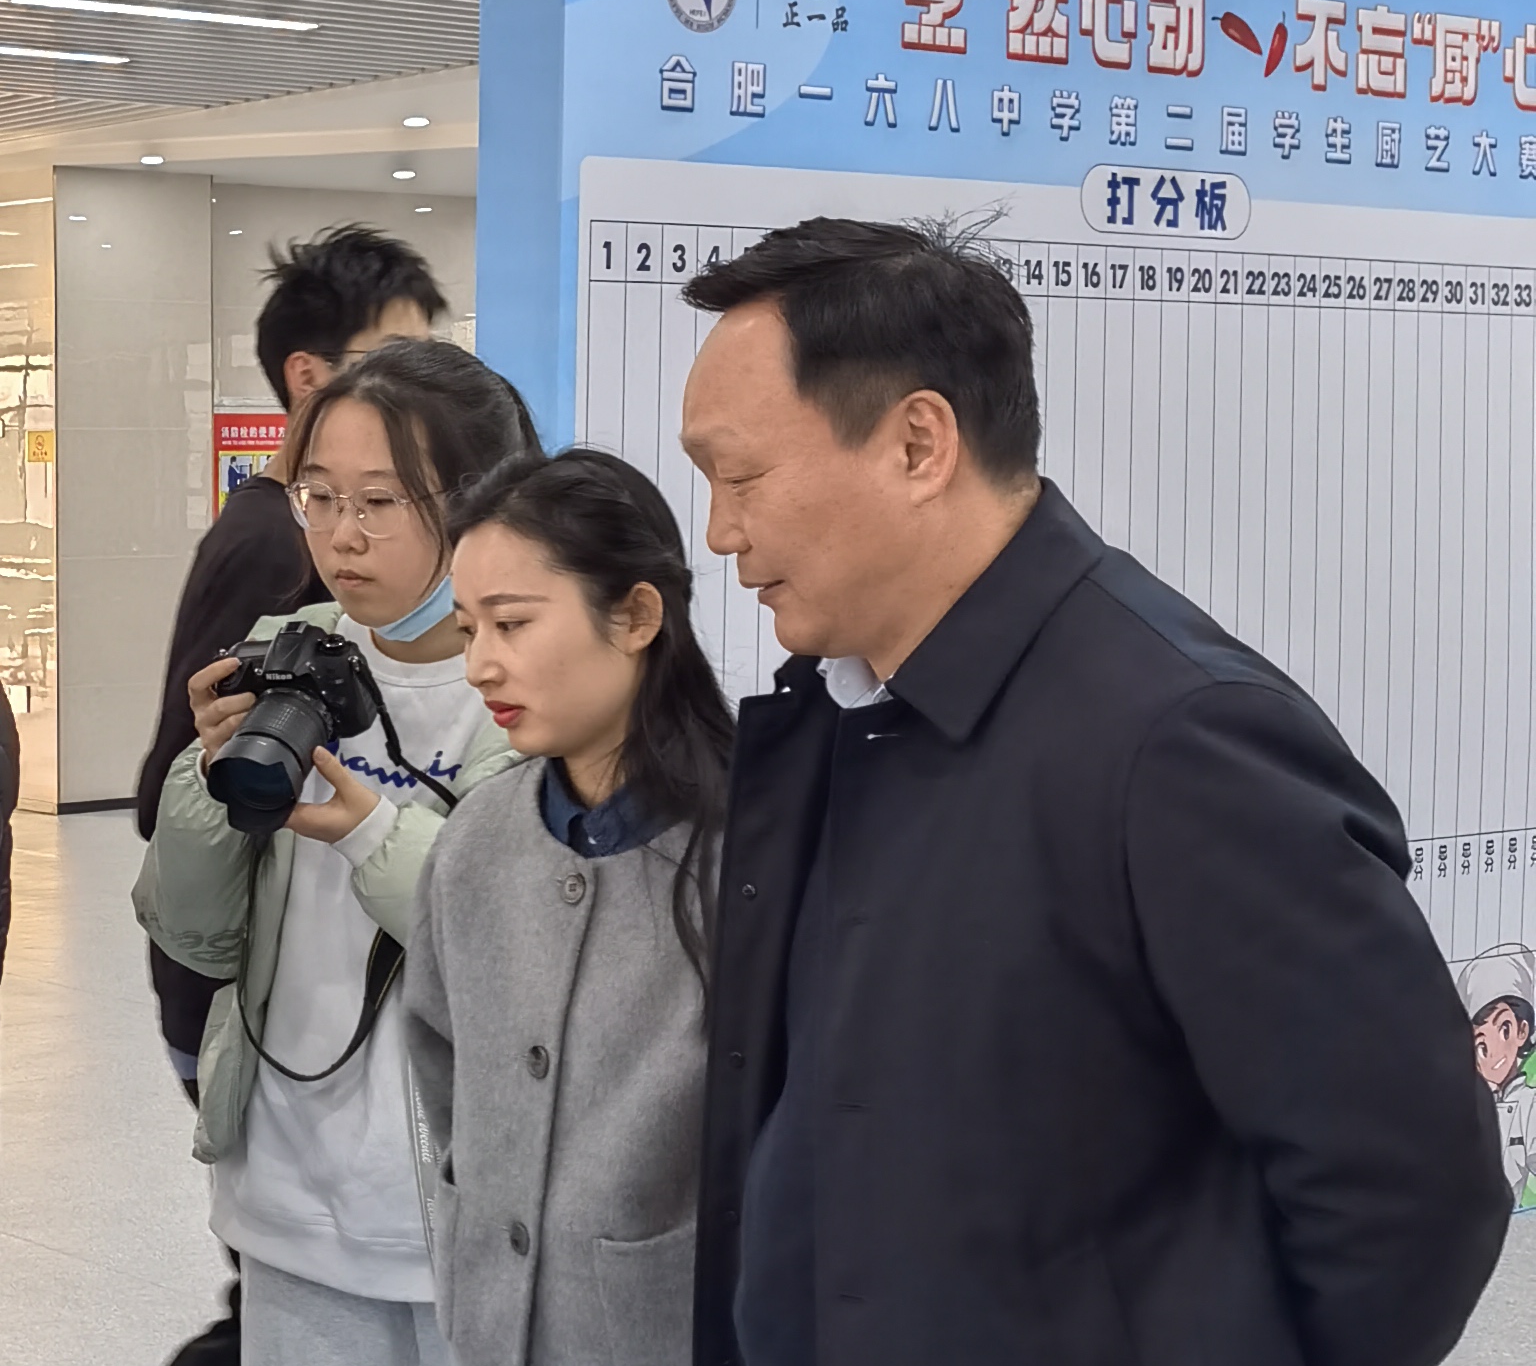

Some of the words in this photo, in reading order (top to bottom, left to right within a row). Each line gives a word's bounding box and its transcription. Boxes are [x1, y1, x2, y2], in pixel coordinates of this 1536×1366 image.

[782, 1, 849, 33] 正一品
[1107, 173, 1228, 232] 打分板
[602, 241, 612, 269] 1
[636, 242, 651, 272] 2
[672, 244, 686, 273] 3
[1024, 260, 1043, 285] 14
[1053, 261, 1071, 286] 15
[1082, 263, 1100, 288] 16
[1110, 264, 1128, 288] 17
[1139, 266, 1156, 290] 18
[1167, 267, 1184, 291] 19
[1191, 268, 1212, 293] 20
[1220, 270, 1237, 294] 21
[1246, 271, 1266, 295] 22
[1271, 272, 1291, 296] 23
[1297, 273, 1317, 297] 24
[1322, 275, 1341, 298] 25
[1347, 276, 1366, 300] 26
[1374, 277, 1392, 300] 27
[1397, 278, 1415, 302] 28
[1421, 280, 1438, 302] 29
[1445, 281, 1463, 304] 30
[1470, 282, 1485, 305] 31
[1492, 284, 1509, 306] 32
[1514, 285, 1532, 307] 33
[265, 673, 293, 681] Nikon
